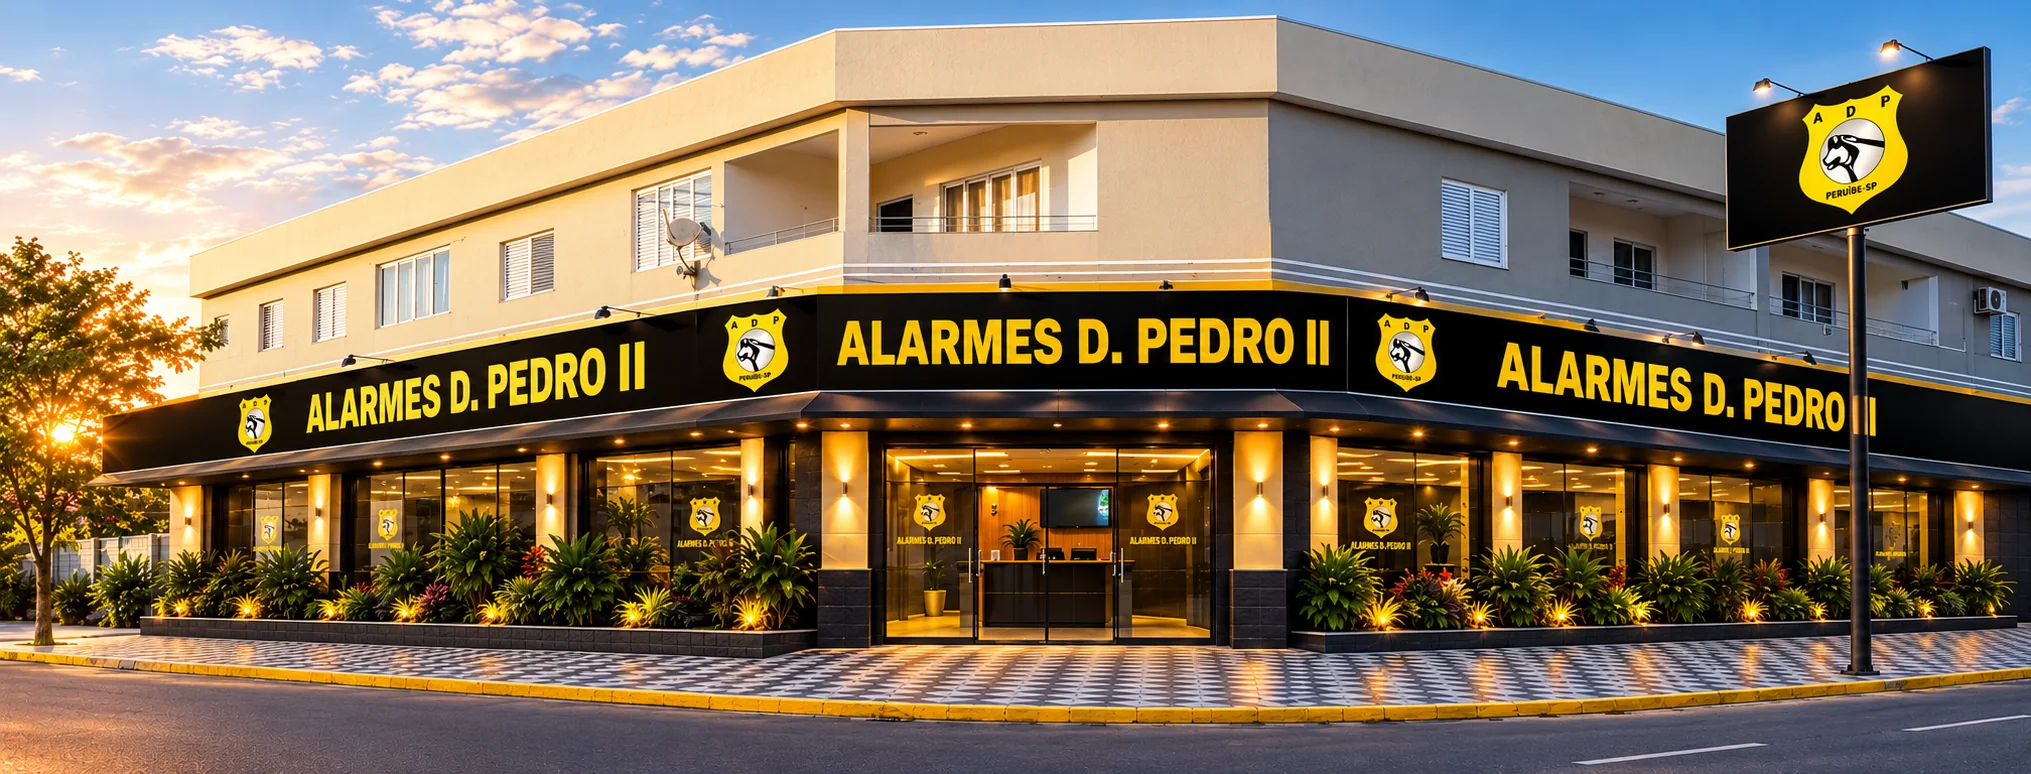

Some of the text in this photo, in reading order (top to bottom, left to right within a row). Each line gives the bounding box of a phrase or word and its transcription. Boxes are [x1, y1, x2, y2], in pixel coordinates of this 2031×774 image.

[1813, 95, 1891, 124] A D P
[837, 317, 1330, 366] ALARMES D. PEDRO II
[306, 341, 645, 434] ALARMES D. PEDRO II
[1497, 342, 1693, 412] ALARMES
[1704, 373, 1735, 418] D.
[1745, 377, 1846, 432] PEDRO
